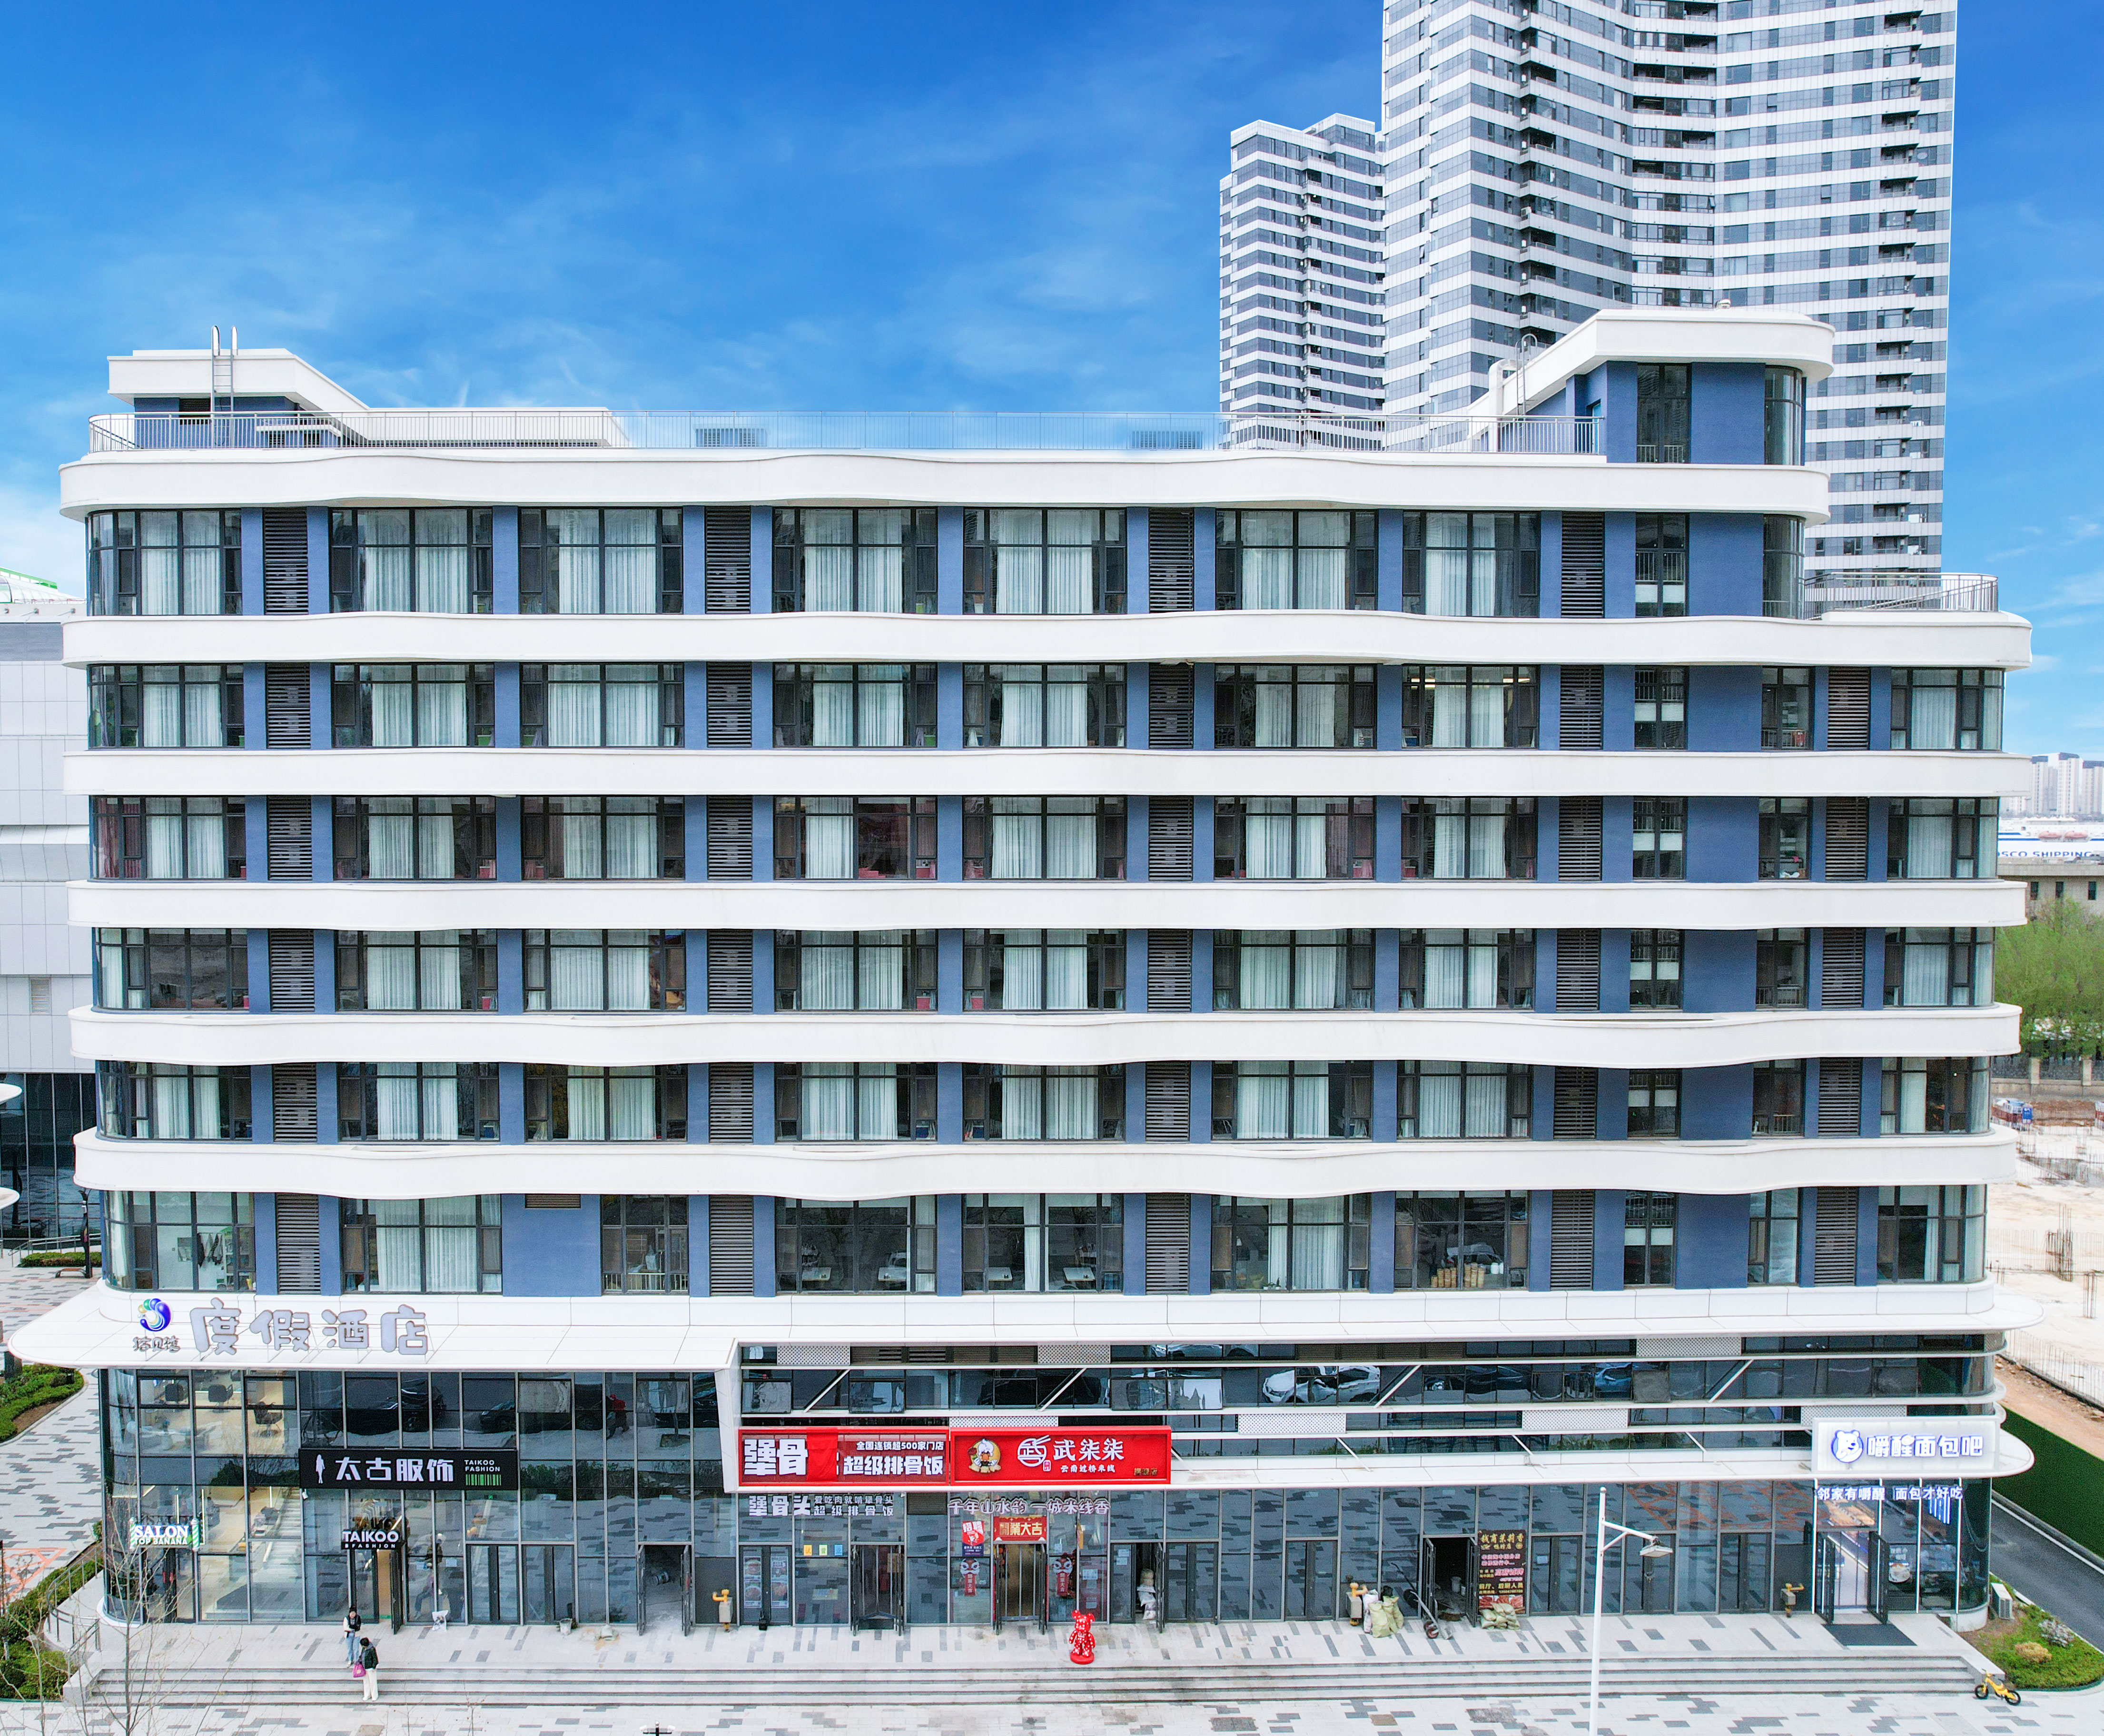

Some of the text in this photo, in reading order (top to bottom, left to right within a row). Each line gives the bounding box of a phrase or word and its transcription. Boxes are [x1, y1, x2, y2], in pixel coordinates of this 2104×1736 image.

[189, 1297, 428, 1355] 度假酒店
[856, 1441, 944, 1451] 全国连锁超500家门店
[1053, 1438, 1125, 1461] 武柒柒
[743, 1439, 840, 1476] 犟骨
[843, 1455, 944, 1476] 超级排骨饭
[335, 1457, 454, 1482] 太古服饰
[1060, 1464, 1116, 1473] 云南过桥米线
[1895, 1486, 1964, 1500] 面包才好吃
[749, 1495, 811, 1517] 犟骨头
[813, 1505, 894, 1517] 超级排骨饭
[948, 1498, 1111, 1515] 千年山水韵 一城米线香
[134, 1525, 190, 1538] SALON
[342, 1530, 399, 1543] TAIKOO
